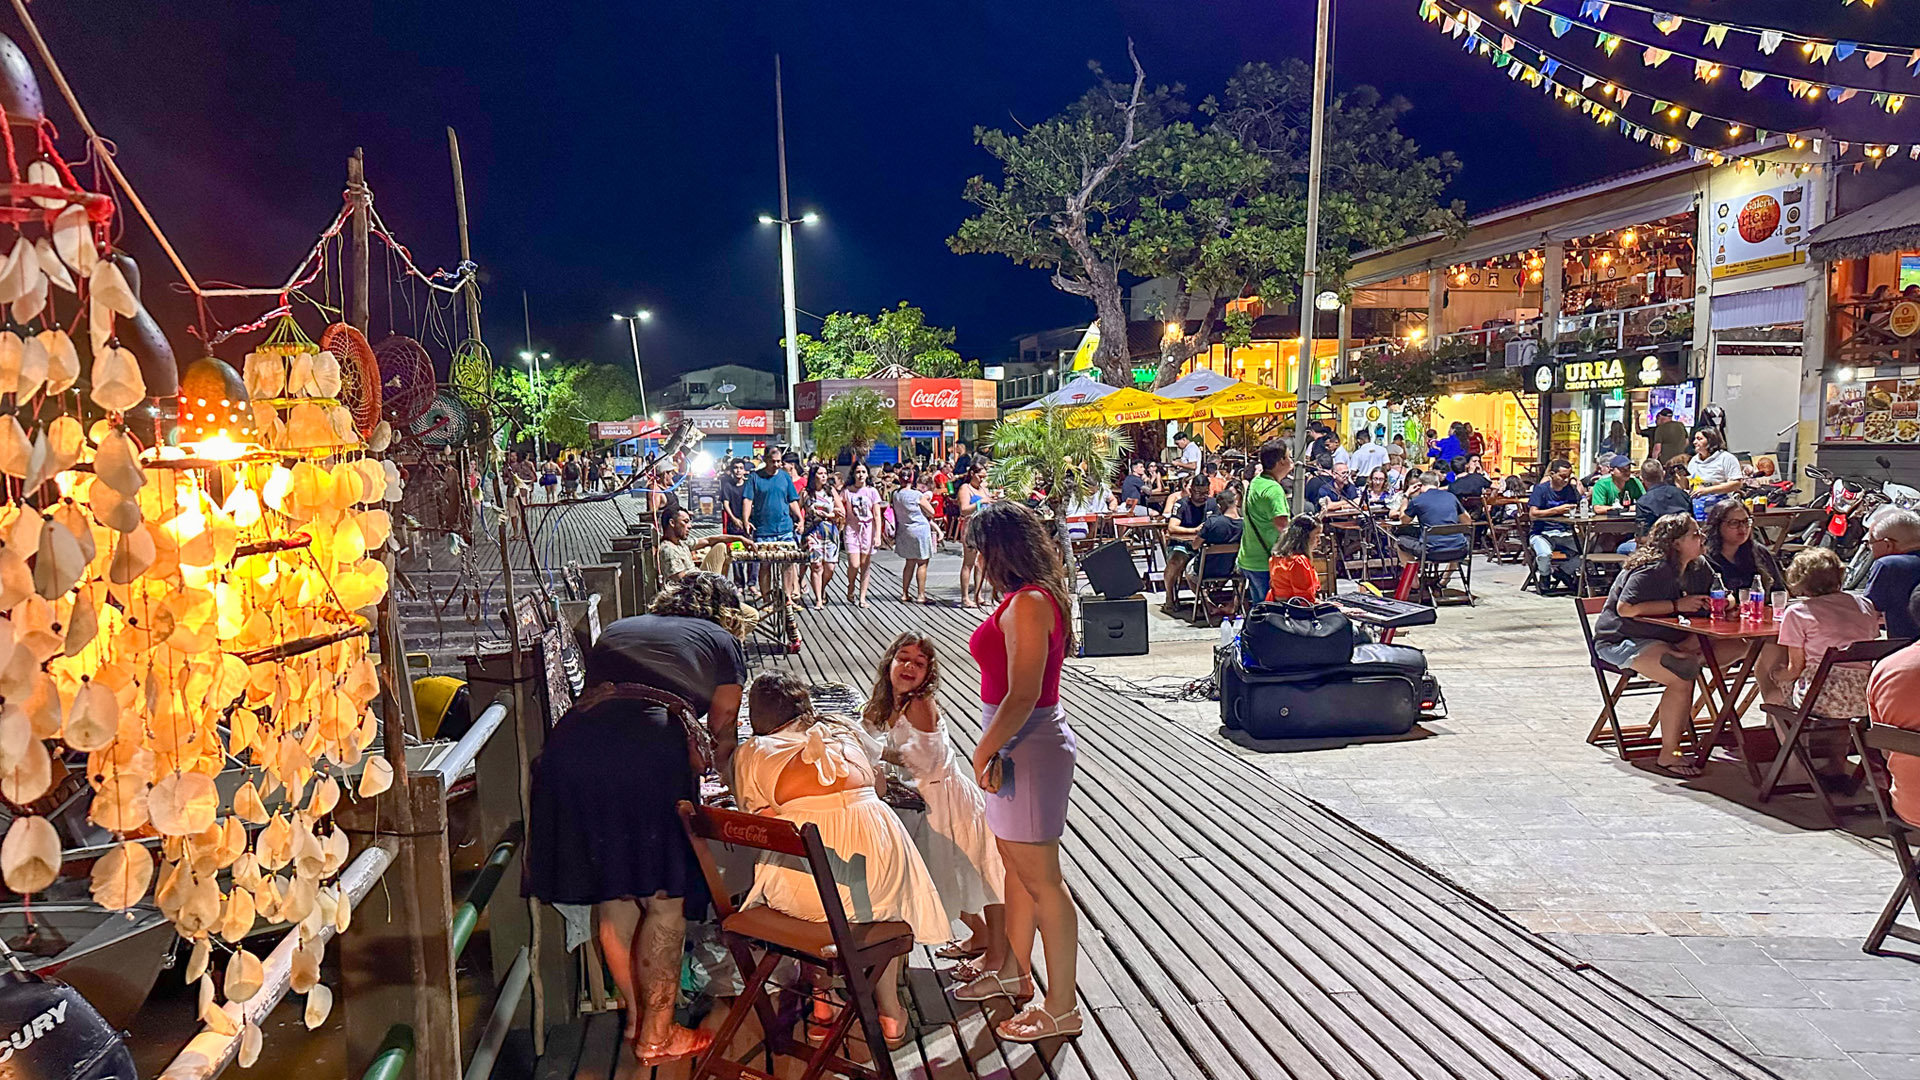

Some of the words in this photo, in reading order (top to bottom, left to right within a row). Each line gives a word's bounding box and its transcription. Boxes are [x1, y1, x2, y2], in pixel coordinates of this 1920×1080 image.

[1745, 198, 1776, 211] Galeria
[1732, 211, 1760, 229] Arte
[1746, 224, 1783, 241] Terra
[1565, 359, 1625, 381] URRA
[1590, 380, 1597, 388] &
[1598, 379, 1625, 388] PORCO
[911, 389, 961, 408] Coca-Cola
[738, 415, 766, 428] Coca-Cola
[1125, 411, 1151, 421] DEVASSA
[724, 821, 768, 844] Coca-Cola
